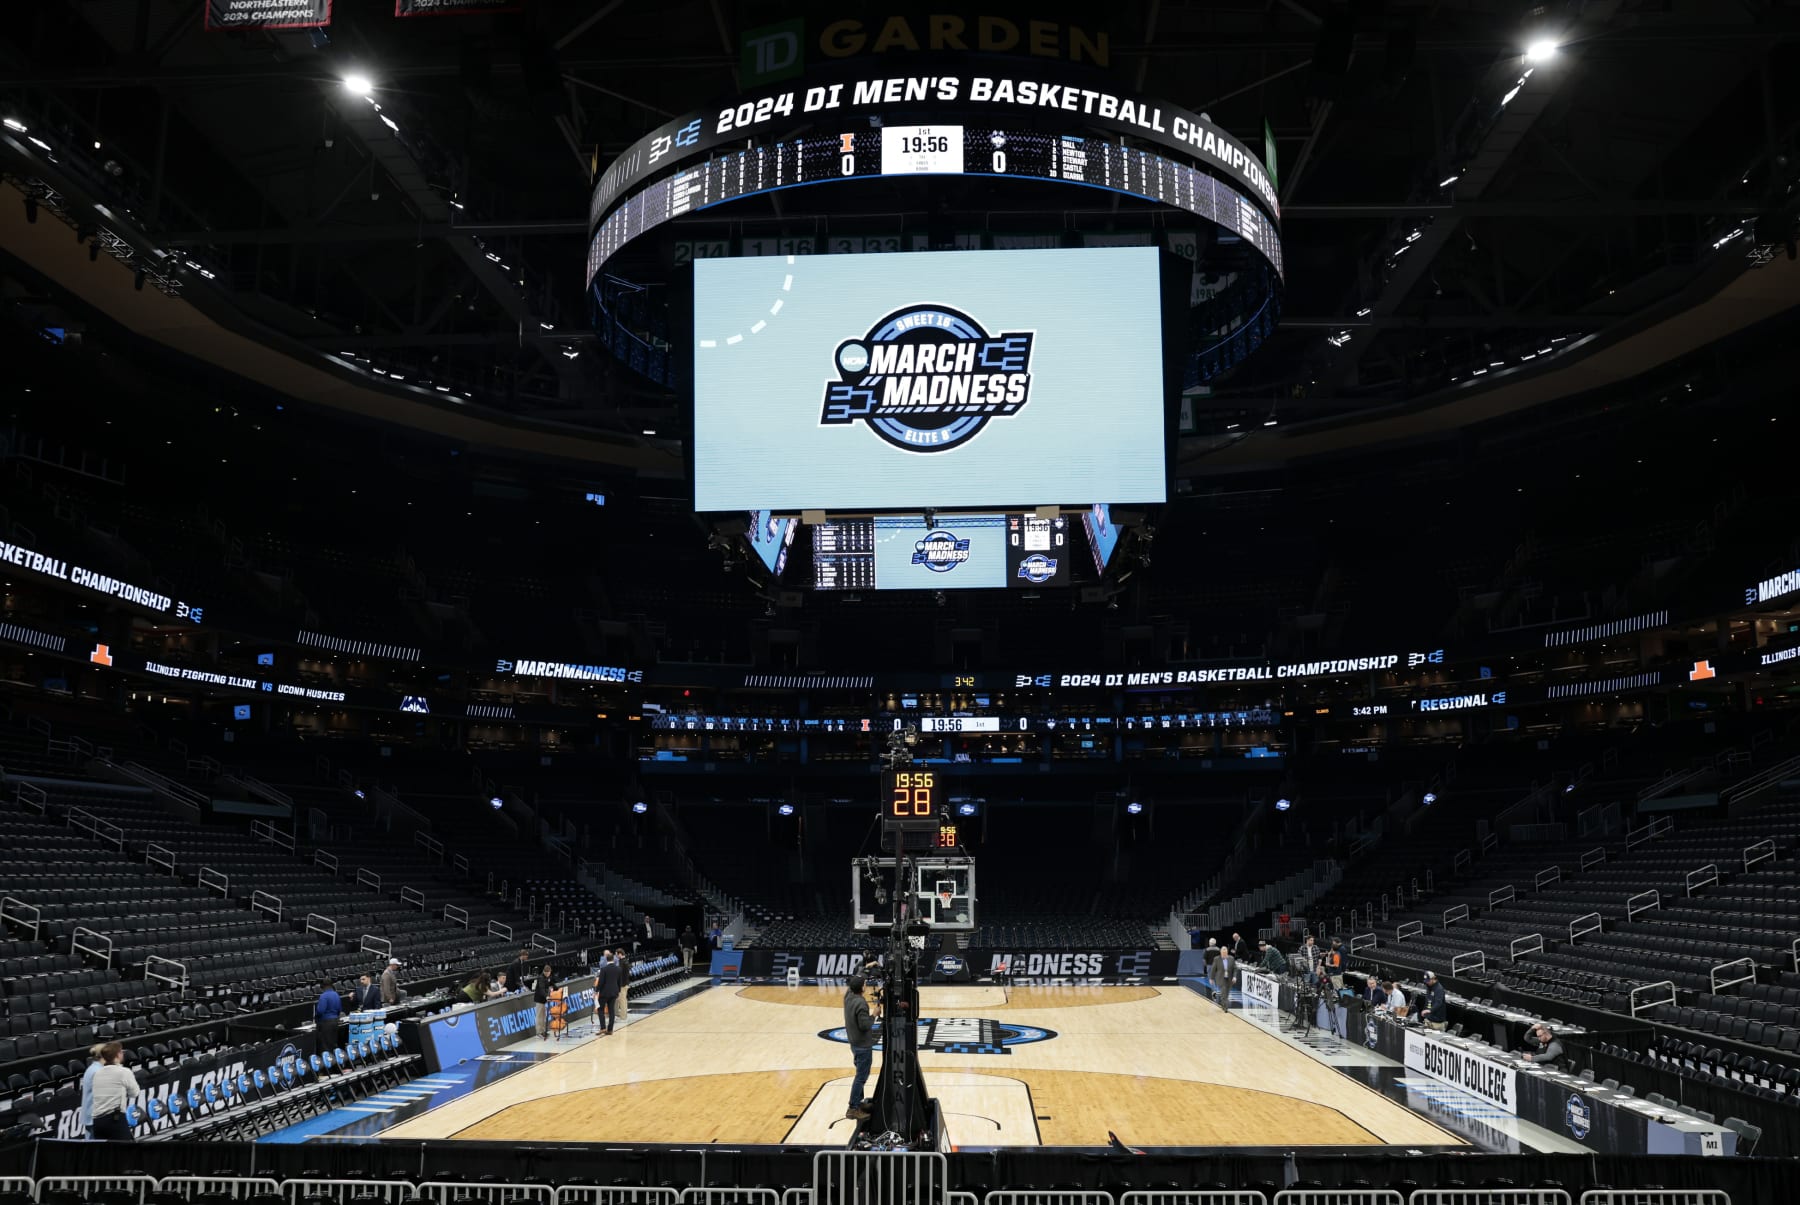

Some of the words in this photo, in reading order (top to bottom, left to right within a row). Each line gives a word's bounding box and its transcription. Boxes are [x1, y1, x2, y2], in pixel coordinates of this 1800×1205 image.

[223, 12, 249, 21] 2024
[251, 9, 314, 20] CHAMPIONS
[745, 31, 798, 74] TD
[818, 15, 1110, 69] GARDEN
[716, 92, 796, 134] 2024
[803, 83, 844, 112] DI
[853, 76, 960, 105] MEN'S
[969, 77, 1165, 133] BASKETBALL
[902, 136, 949, 153] 19:56
[841, 155, 854, 175] 0
[993, 151, 1006, 172] 0
[896, 313, 935, 331] SWEET
[869, 342, 976, 375] MARCH
[882, 374, 1028, 407] MADNESS
[904, 430, 939, 443] ELITE
[924, 541, 955, 551] MARCH
[927, 549, 969, 561] MADNESS
[71, 566, 172, 612] CHAMPIONSHIP
[1761, 650, 1795, 665] ILLINOIS
[1060, 675, 1101, 687] 2024
[1105, 674, 1123, 685] DI
[1127, 672, 1174, 685] MEN'S
[1177, 666, 1273, 683] BASKETBALL
[1277, 655, 1398, 678] CHAMPIONSHIP
[145, 661, 180, 678] ILLINOIS
[180, 668, 227, 685] FIGHTING
[226, 676, 258, 690] ILLINI
[261, 681, 274, 693] VS
[277, 684, 306, 697] UCONN
[306, 687, 346, 702] HUSKIES
[1353, 706, 1372, 716] 3:42
[1373, 705, 1388, 714] PM
[1420, 694, 1488, 711] REGIONAL
[930, 719, 963, 731] 19:56
[896, 773, 934, 788] 19:56
[893, 789, 930, 815] 28
[991, 953, 1104, 976] MADNESS
[500, 1007, 538, 1036] WELCOM
[1424, 1041, 1462, 1085] BOSTON
[1464, 1056, 1508, 1105] COLLEGE
